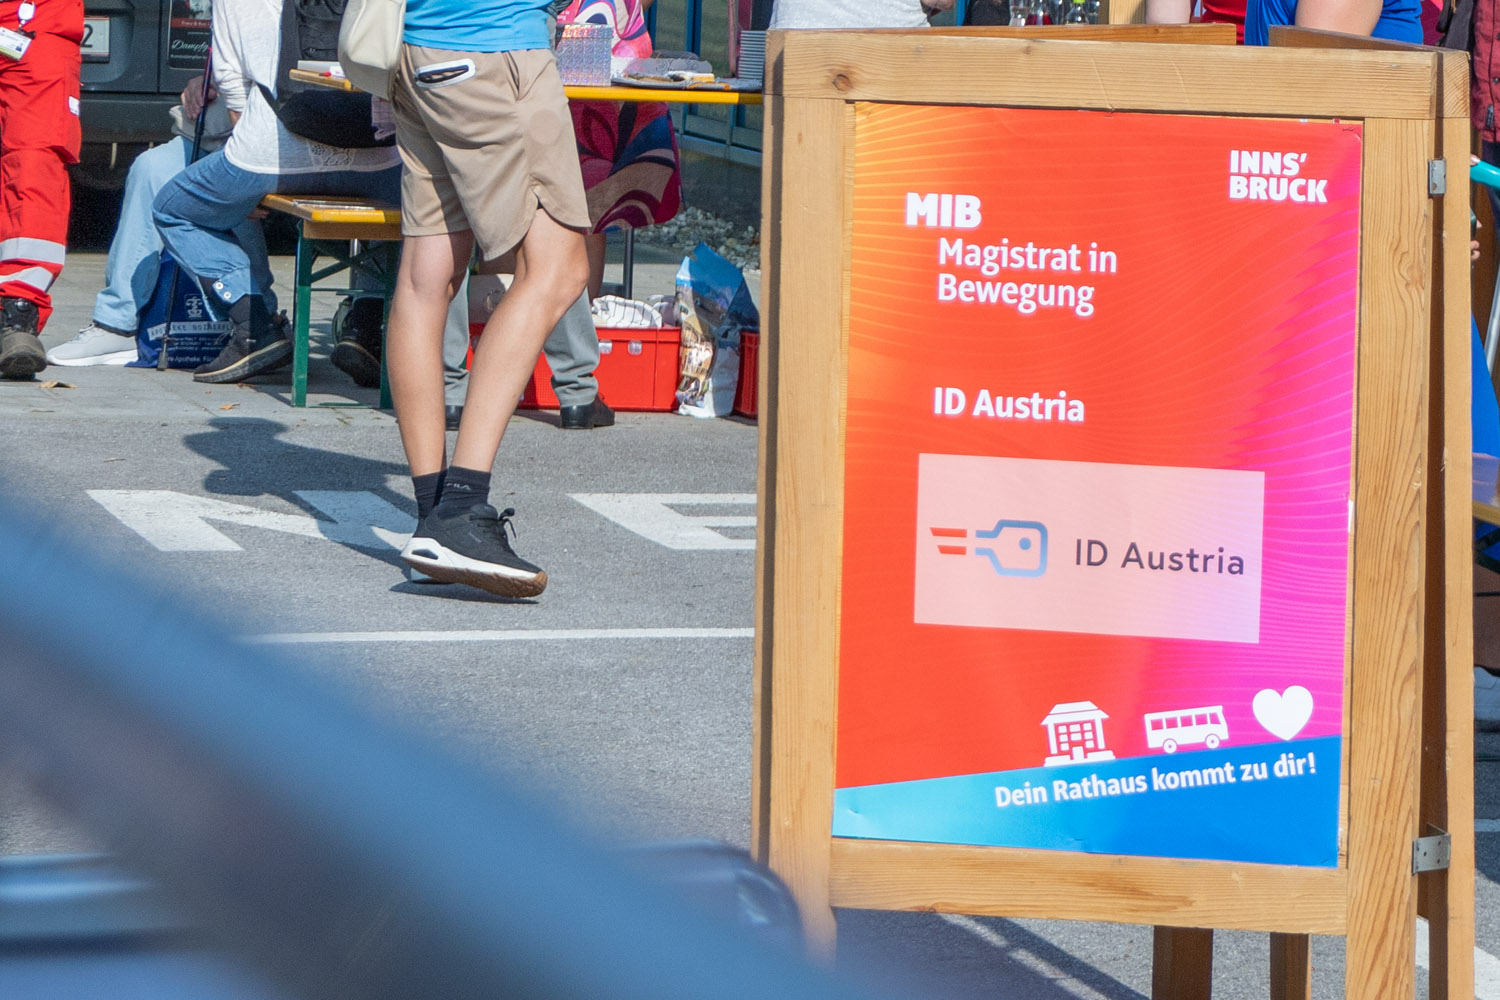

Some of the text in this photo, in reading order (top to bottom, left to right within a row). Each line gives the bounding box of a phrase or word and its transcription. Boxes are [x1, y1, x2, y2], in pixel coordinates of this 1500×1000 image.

[1229, 150, 1307, 176] INNS'
[1228, 176, 1328, 203] BRUCK
[905, 192, 982, 229] MIB
[938, 237, 1118, 276] Magistrat in
[937, 273, 1096, 317] Bewegung
[934, 386, 1085, 422] ID Austria
[1076, 539, 1245, 576] ID Austria
[995, 752, 1316, 808] Dein Rathaus kommt zu dir!
